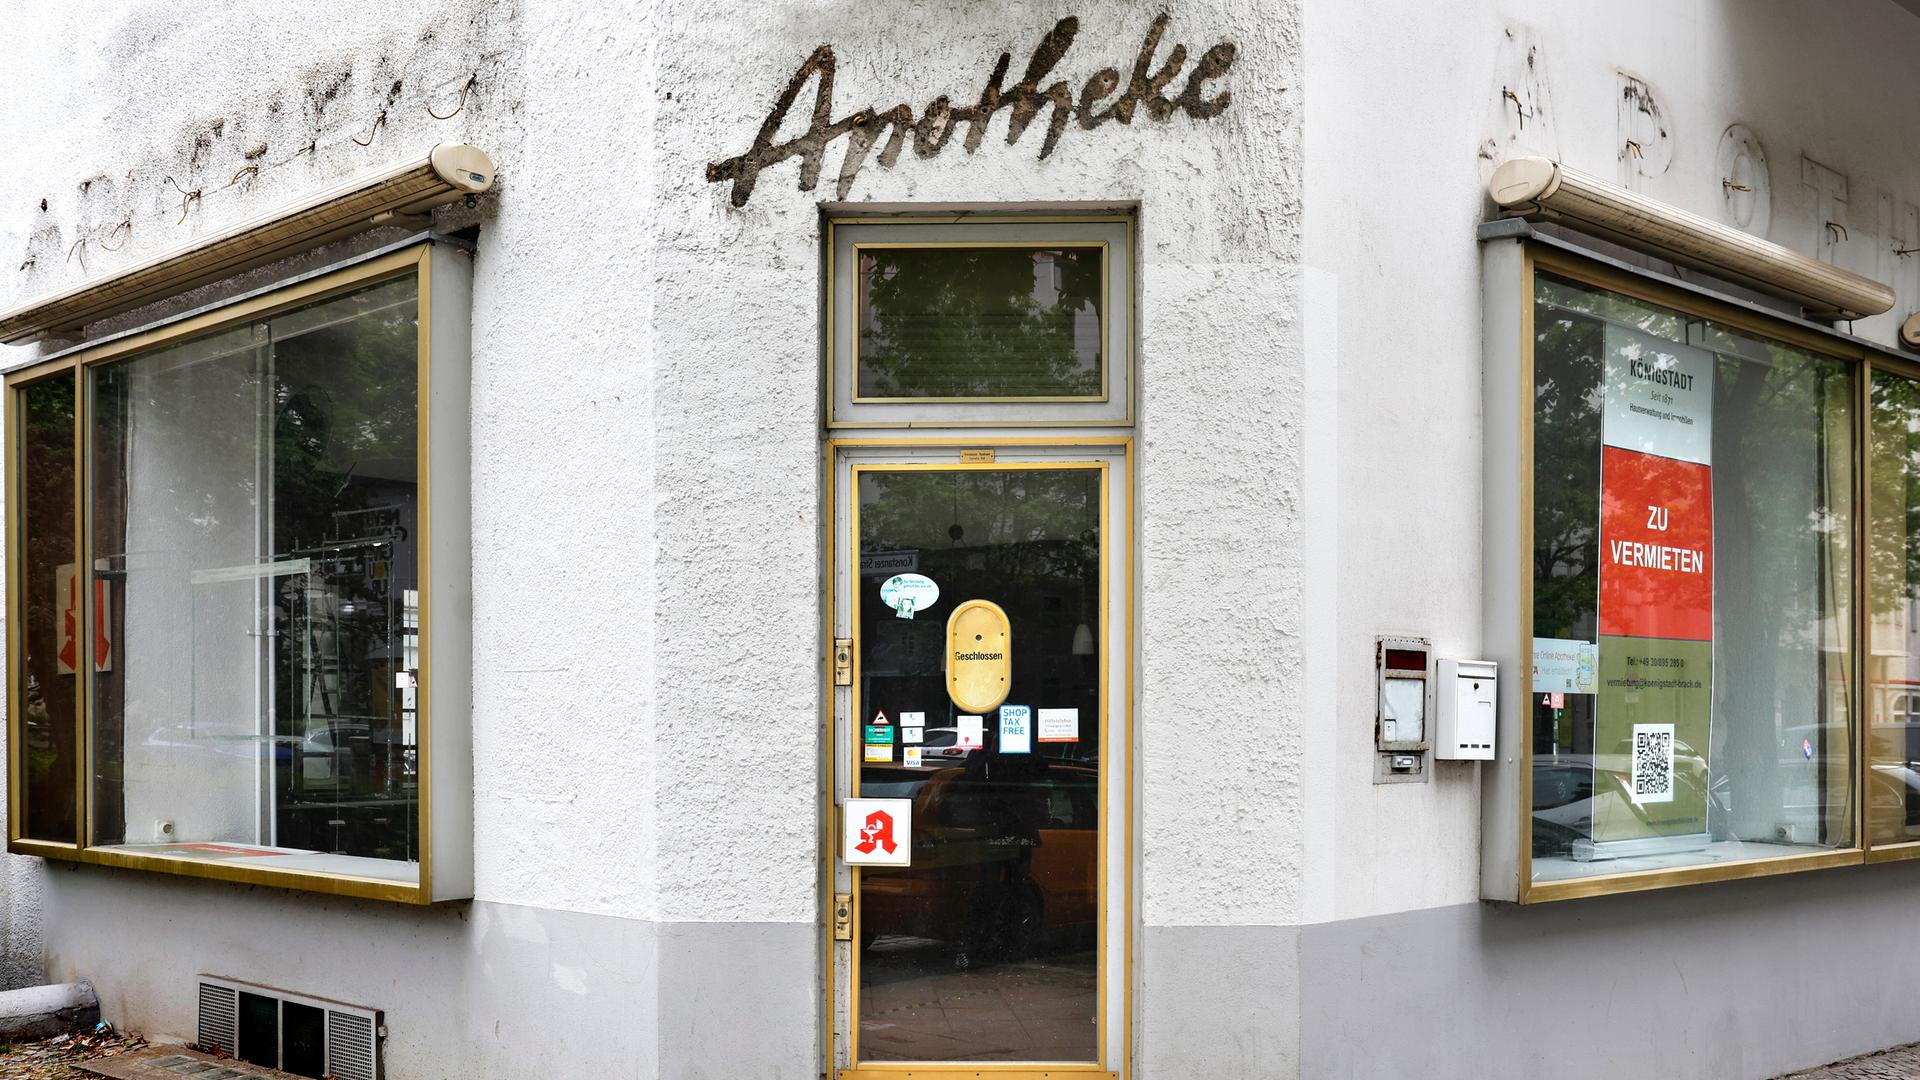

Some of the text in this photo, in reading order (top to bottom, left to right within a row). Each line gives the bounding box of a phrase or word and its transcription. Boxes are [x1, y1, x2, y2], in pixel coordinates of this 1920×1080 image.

[1630, 358, 1694, 391] KÖNIGSTADT
[1647, 505, 1669, 531] ZU
[1610, 539, 1703, 574] VERMIETEN
[954, 651, 1003, 661] Geschlossen
[1003, 708, 1027, 717] SHOP
[1003, 718, 1020, 726] TAX
[1003, 727, 1025, 735] FREE
